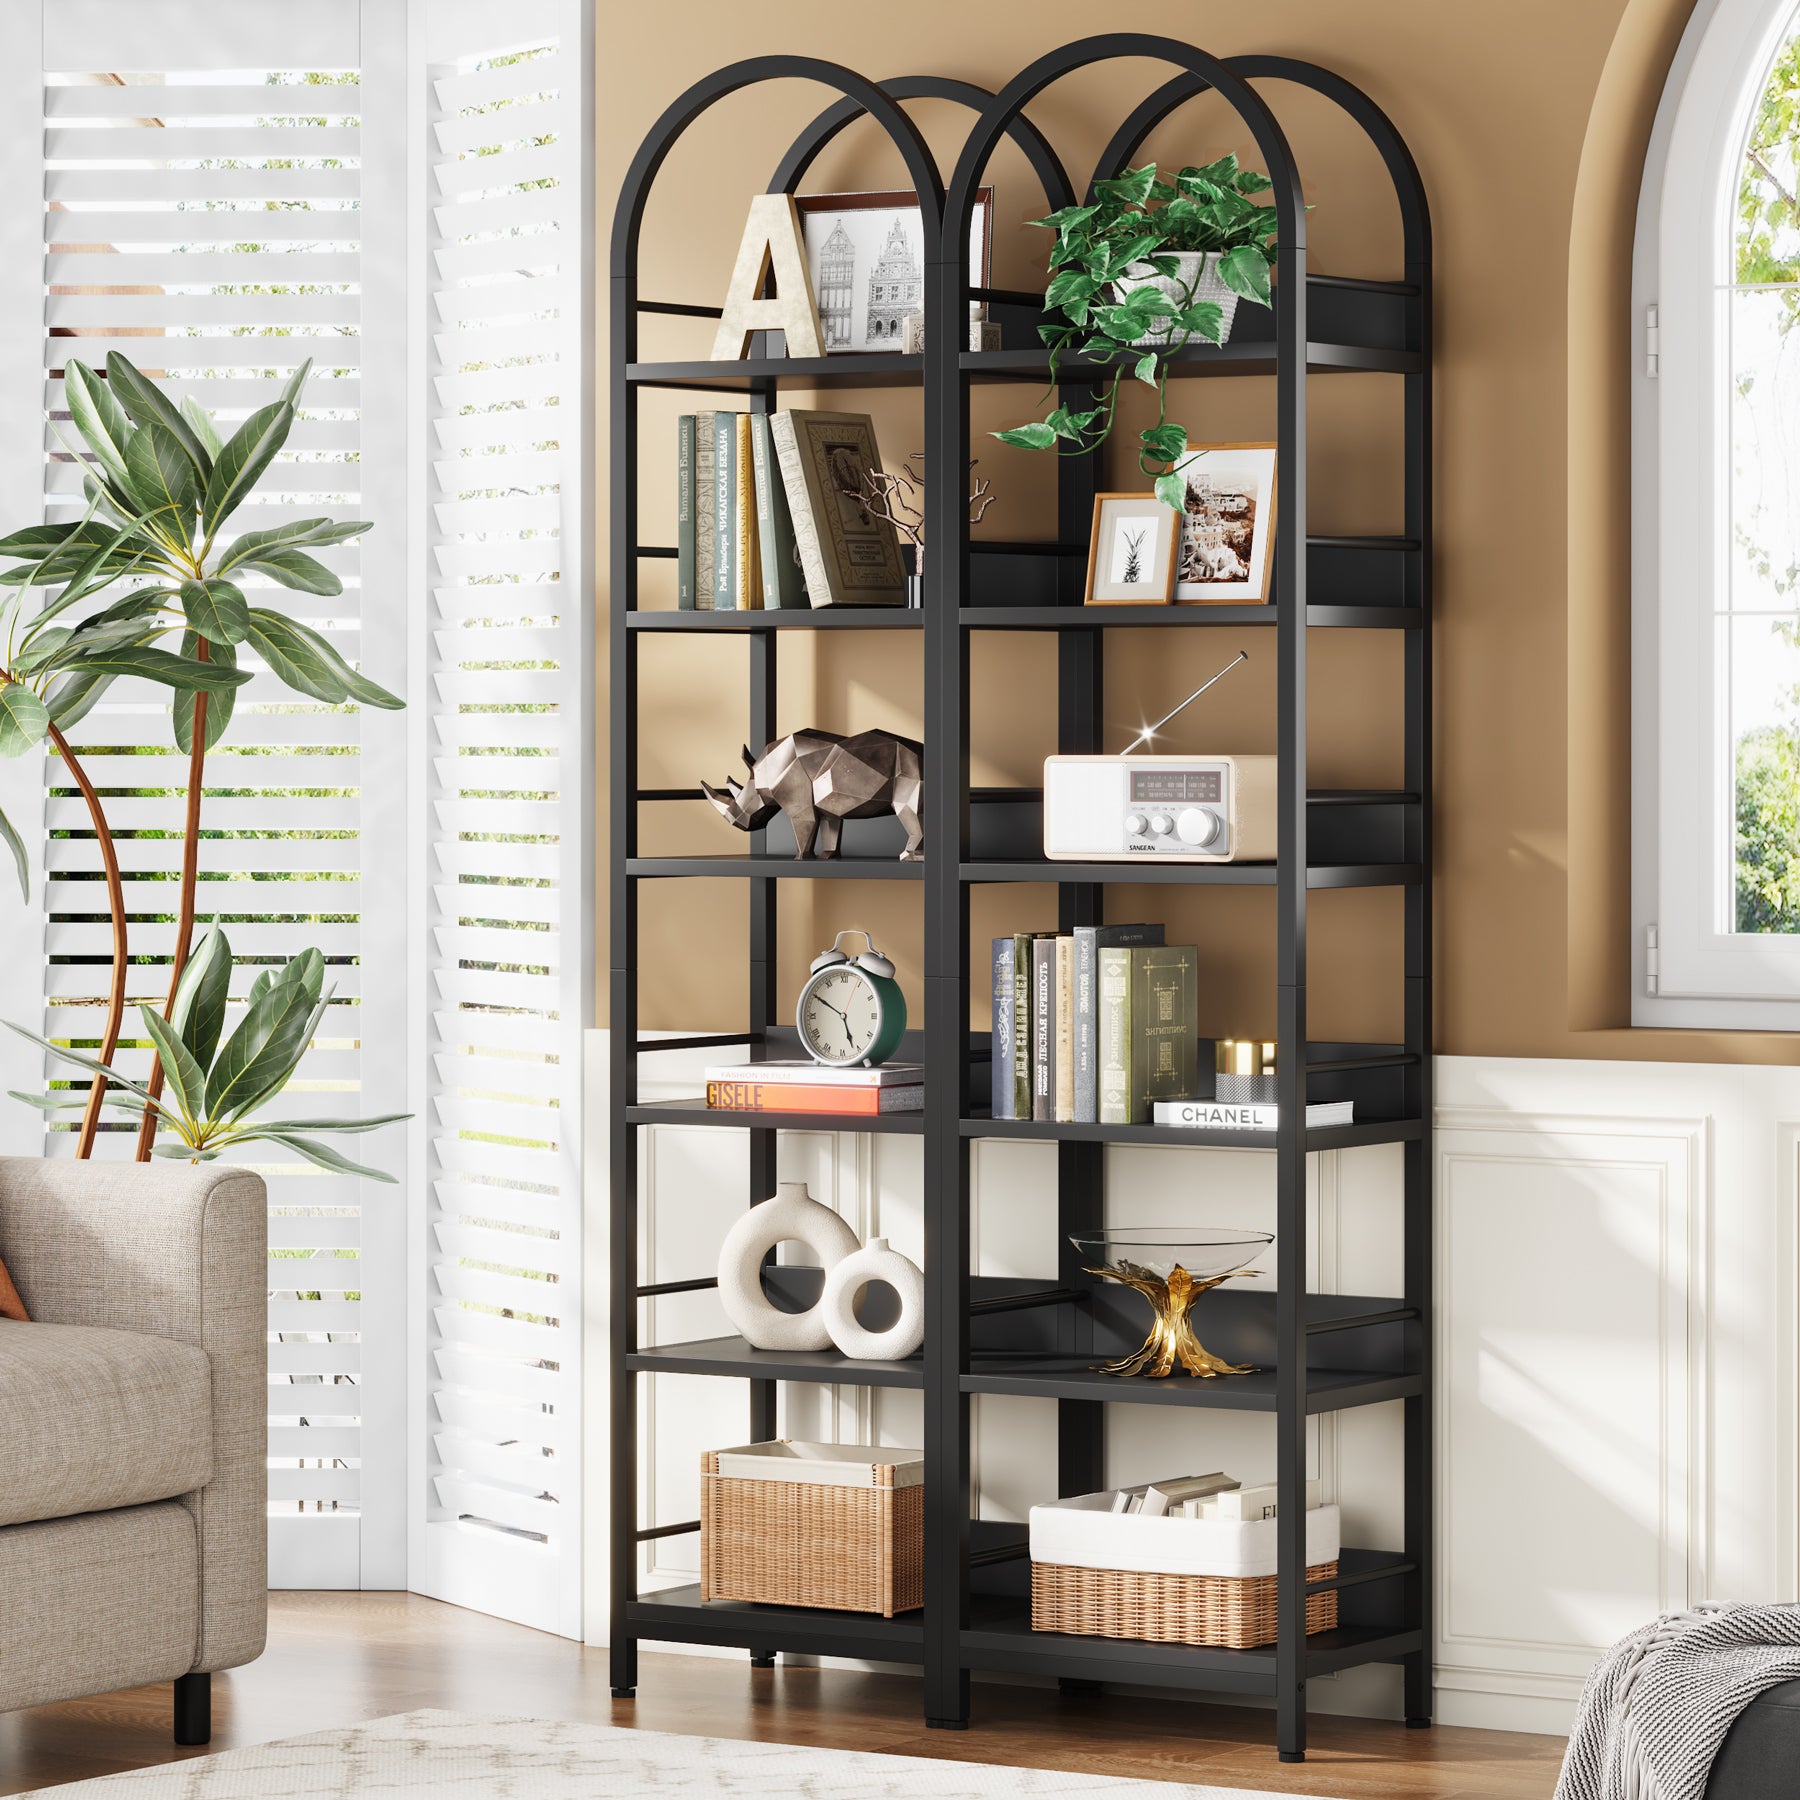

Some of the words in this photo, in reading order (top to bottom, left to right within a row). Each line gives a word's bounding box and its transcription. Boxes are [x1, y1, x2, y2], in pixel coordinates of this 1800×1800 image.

[711, 193, 827, 361] A
[680, 424, 689, 467] Бианки
[719, 428, 728, 468] БЕЗДНА
[719, 471, 728, 531] ЧИКАГСКАЯ
[1039, 962, 1048, 1015] КРЕПОСТЬ
[1079, 973, 1089, 1013] ЗОЛОТОЙ
[1039, 1018, 1048, 1062] ЛЕСНАЯ
[706, 1082, 763, 1107] GISELE
[1182, 1107, 1263, 1125] CHANEL
